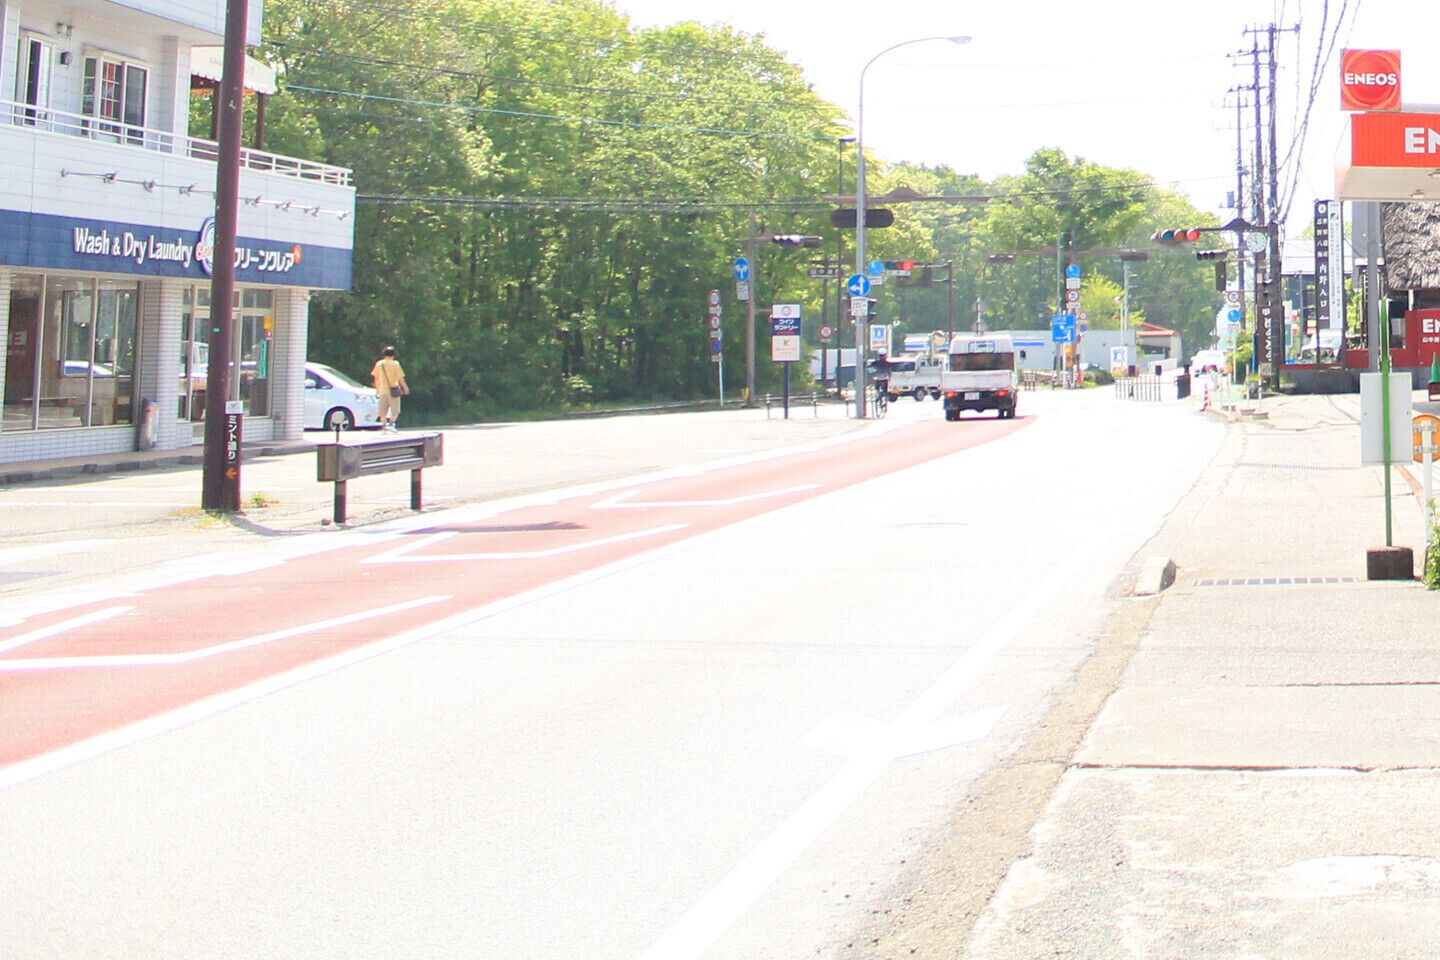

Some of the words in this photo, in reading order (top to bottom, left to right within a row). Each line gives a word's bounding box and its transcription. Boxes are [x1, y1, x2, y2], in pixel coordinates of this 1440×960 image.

[1344, 73, 1398, 86] ENEOS
[73, 226, 109, 255] Wash
[111, 237, 121, 256] &
[123, 231, 147, 265] Dry
[148, 235, 193, 268] Laundry
[227, 415, 237, 460] ミント通り
